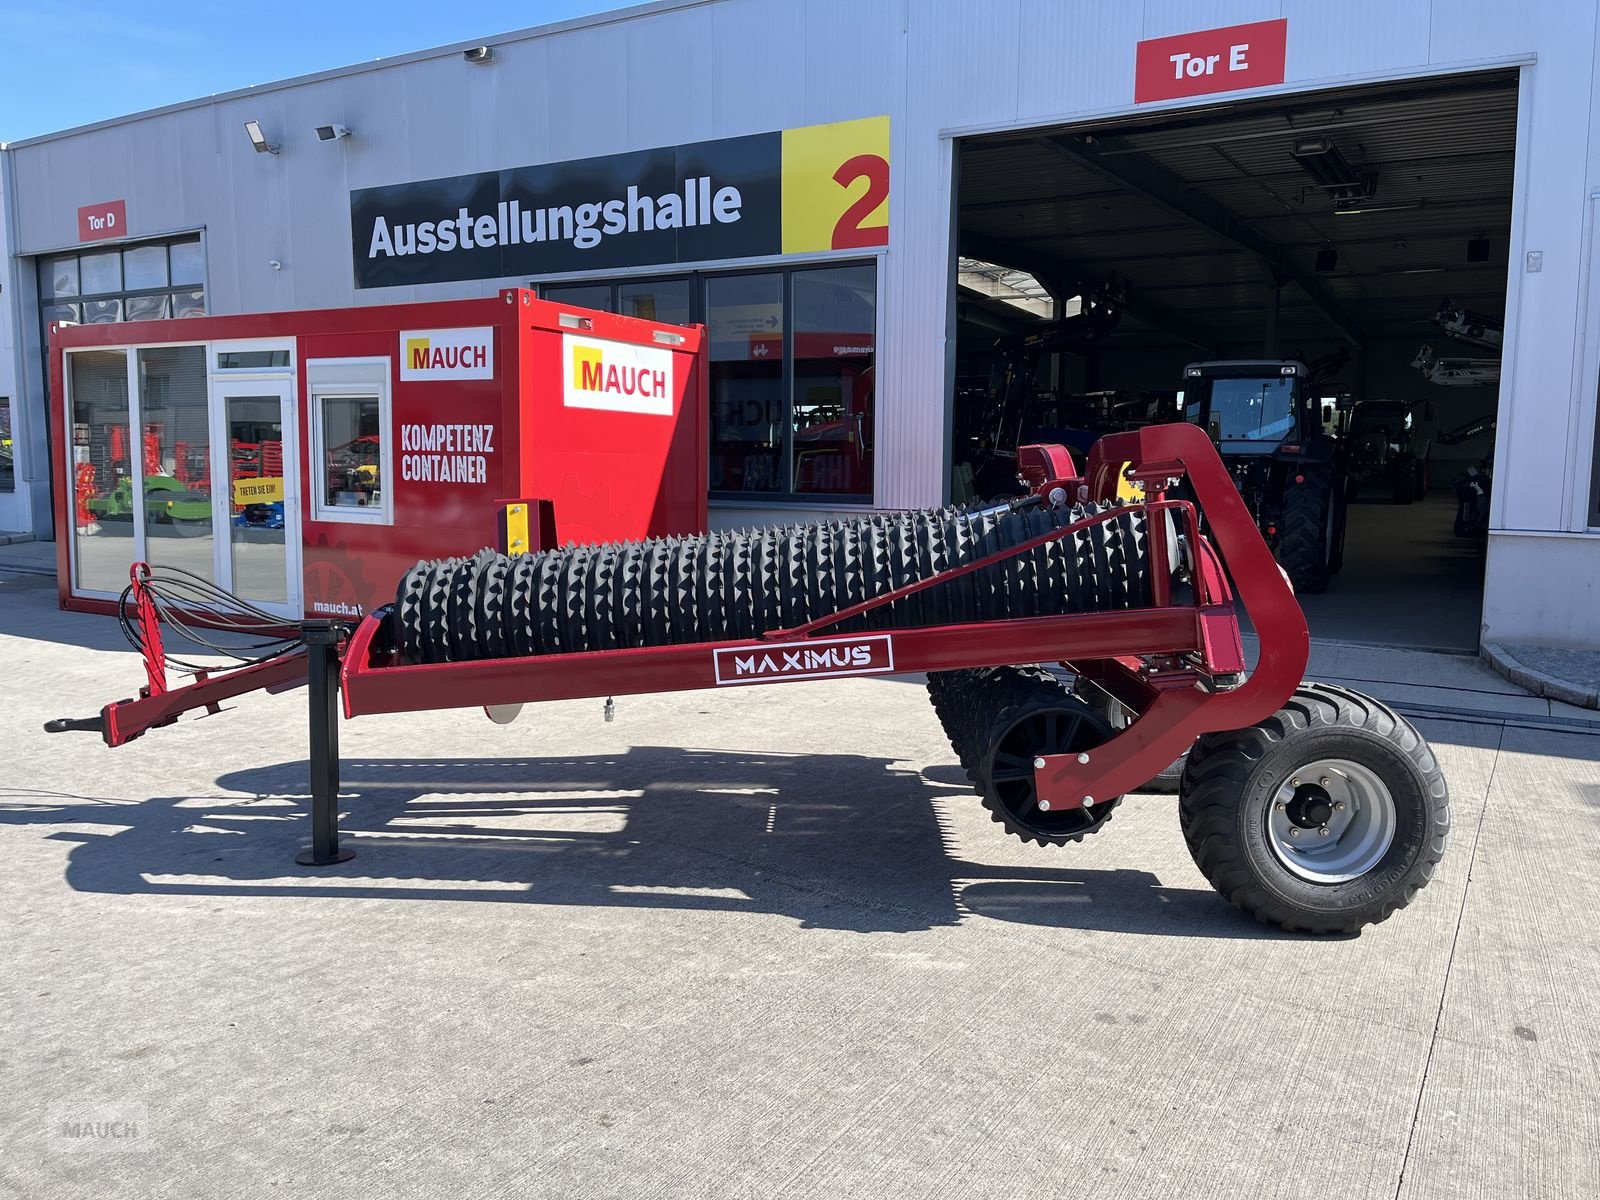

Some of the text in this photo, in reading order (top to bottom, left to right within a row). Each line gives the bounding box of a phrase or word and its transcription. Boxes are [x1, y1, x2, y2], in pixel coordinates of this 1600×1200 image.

[1169, 43, 1249, 79] Tor E
[368, 153, 889, 258] Ausstellungshalle 2
[88, 212, 115, 230] Tor D
[413, 345, 487, 370] MAUCH
[582, 360, 665, 398] MAUCH
[401, 424, 494, 453] KOMPETENZ
[402, 454, 487, 484] CONTAINER
[240, 486, 257, 496] TRETEN
[257, 485, 266, 495] SIE
[314, 601, 363, 616] mauch.at
[735, 645, 871, 675] MAXIMUS
